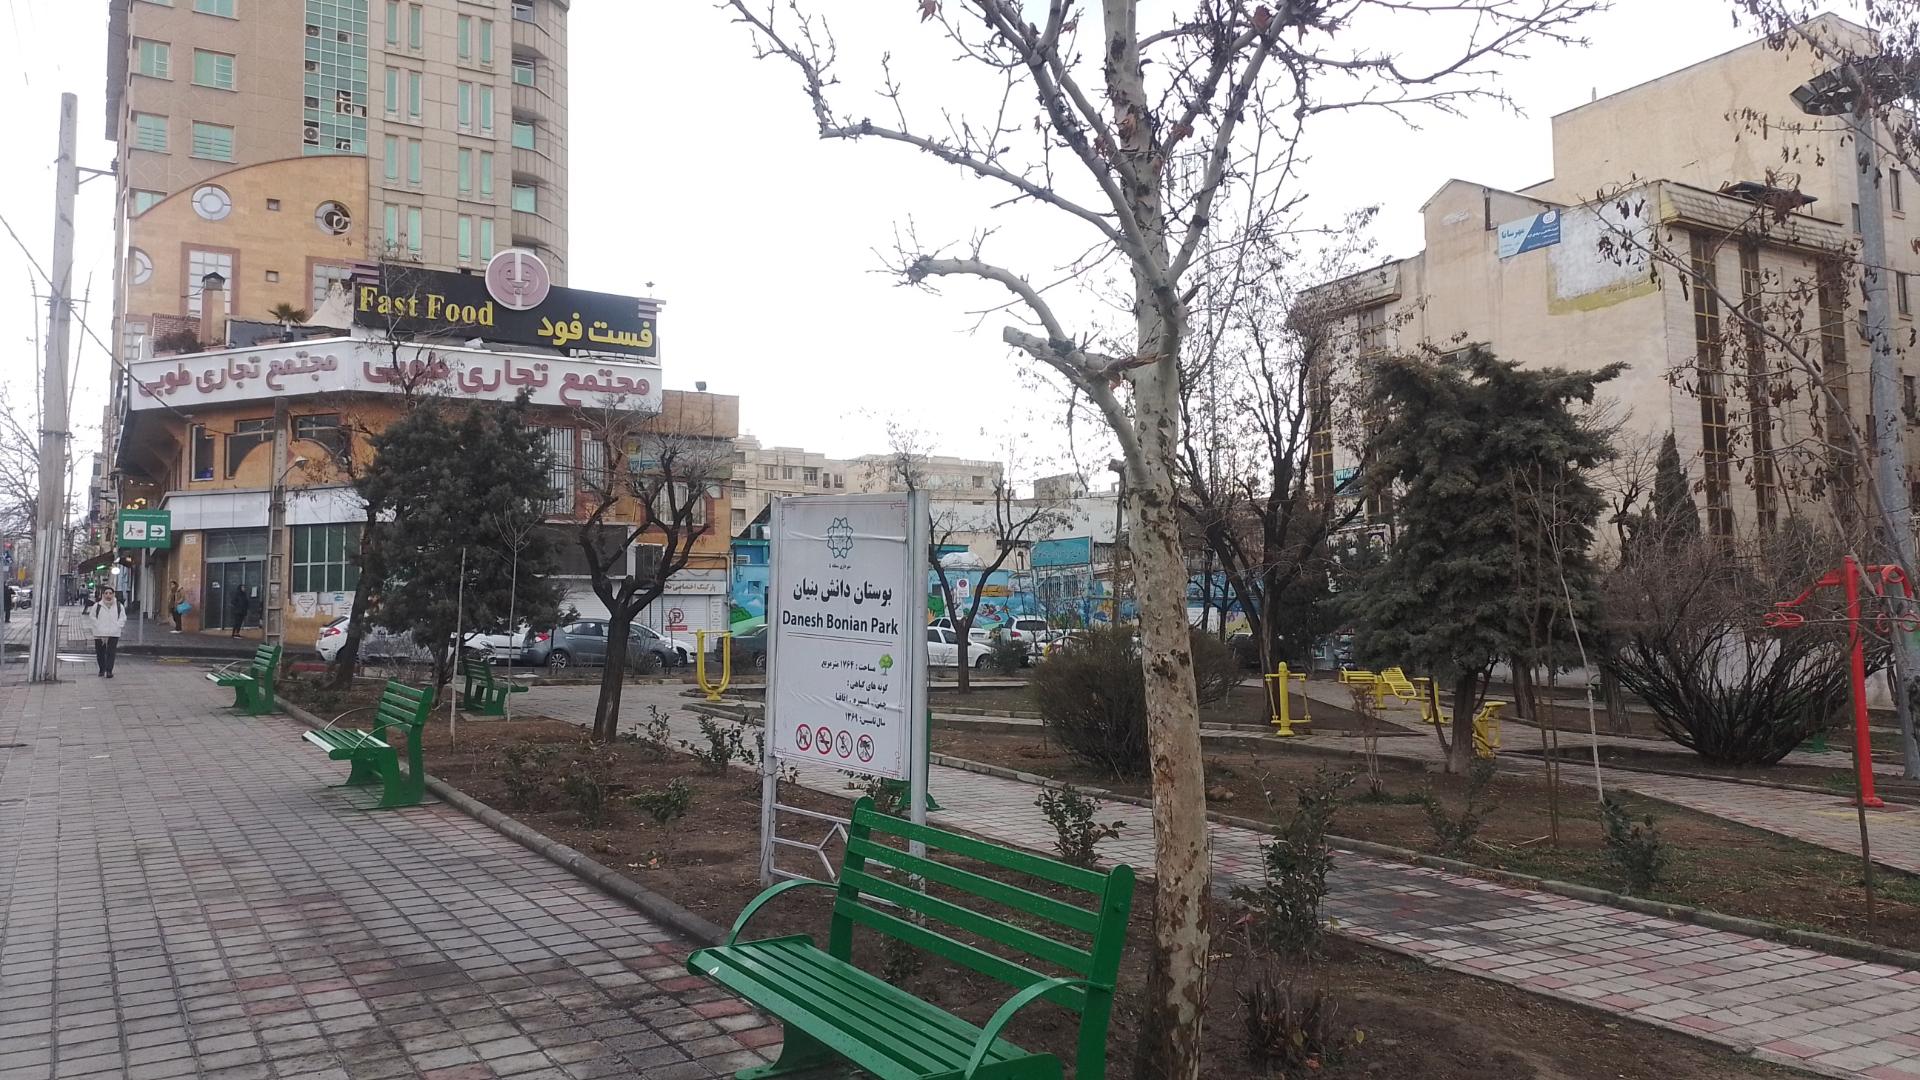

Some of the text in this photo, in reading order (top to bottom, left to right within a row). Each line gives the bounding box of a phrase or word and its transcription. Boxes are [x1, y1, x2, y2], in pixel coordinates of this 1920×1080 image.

[359, 286, 494, 326] Fast Food
[537, 312, 653, 348] فست فود
[138, 350, 338, 397] مجتمع تجاری طوبی
[457, 359, 549, 396] تجاری
[558, 368, 650, 406] مجتمع
[793, 577, 892, 607] بوستان دانش بنیان
[783, 610, 898, 635] Danesh Bonian Park
